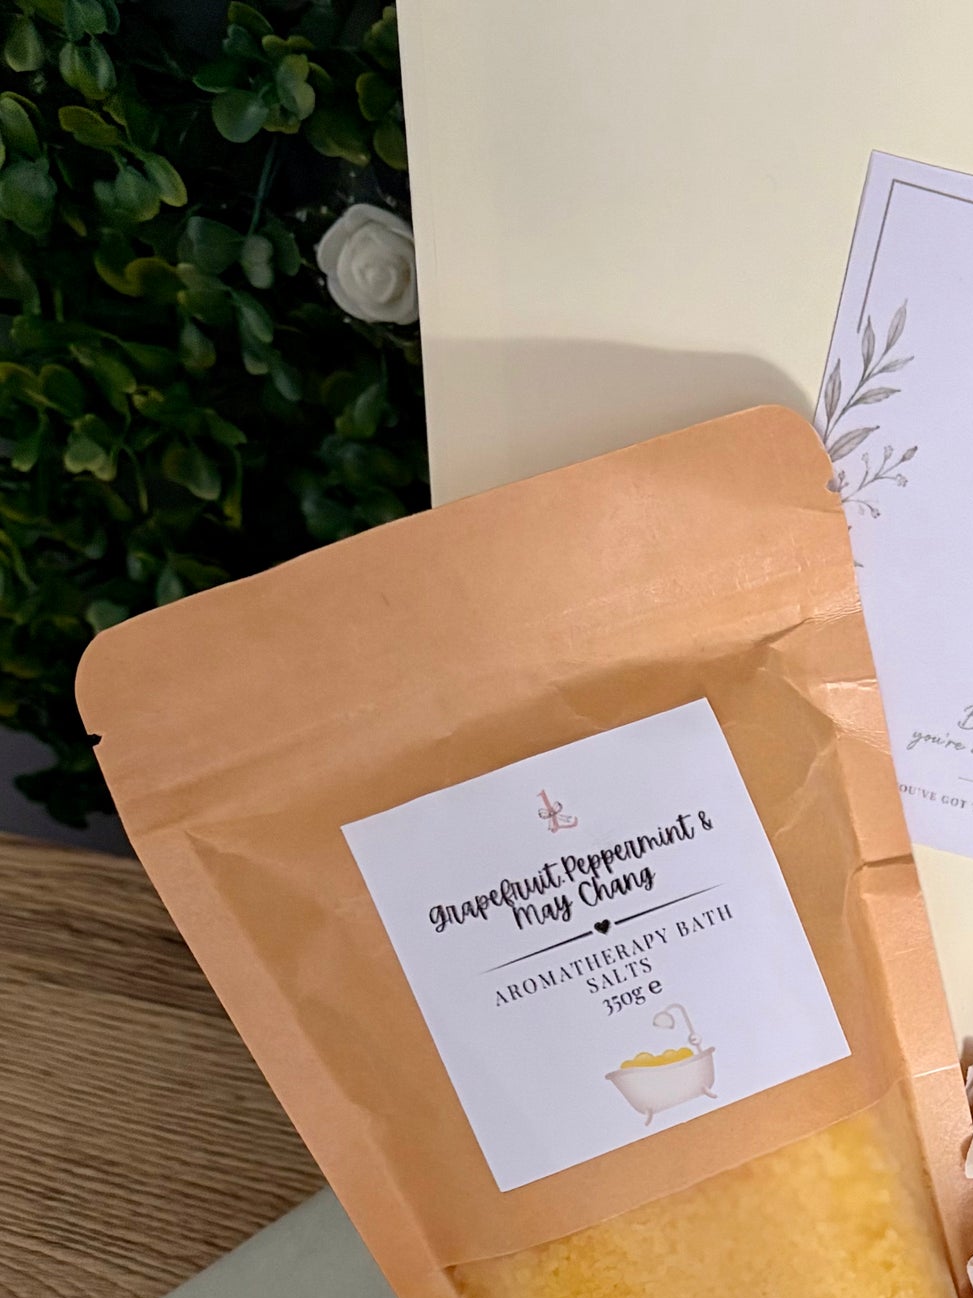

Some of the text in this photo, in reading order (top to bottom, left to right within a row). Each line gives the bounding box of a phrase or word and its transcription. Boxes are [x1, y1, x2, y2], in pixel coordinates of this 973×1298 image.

[906, 731, 966, 751] you're
[898, 783, 937, 801] OU'VE
[941, 794, 967, 809] GOT
[698, 811, 714, 831] &
[512, 866, 656, 930] May Chang
[495, 904, 734, 1007] AROMATHERAPY BATH
[586, 957, 653, 994] SALTS
[603, 986, 647, 1016] 350g
